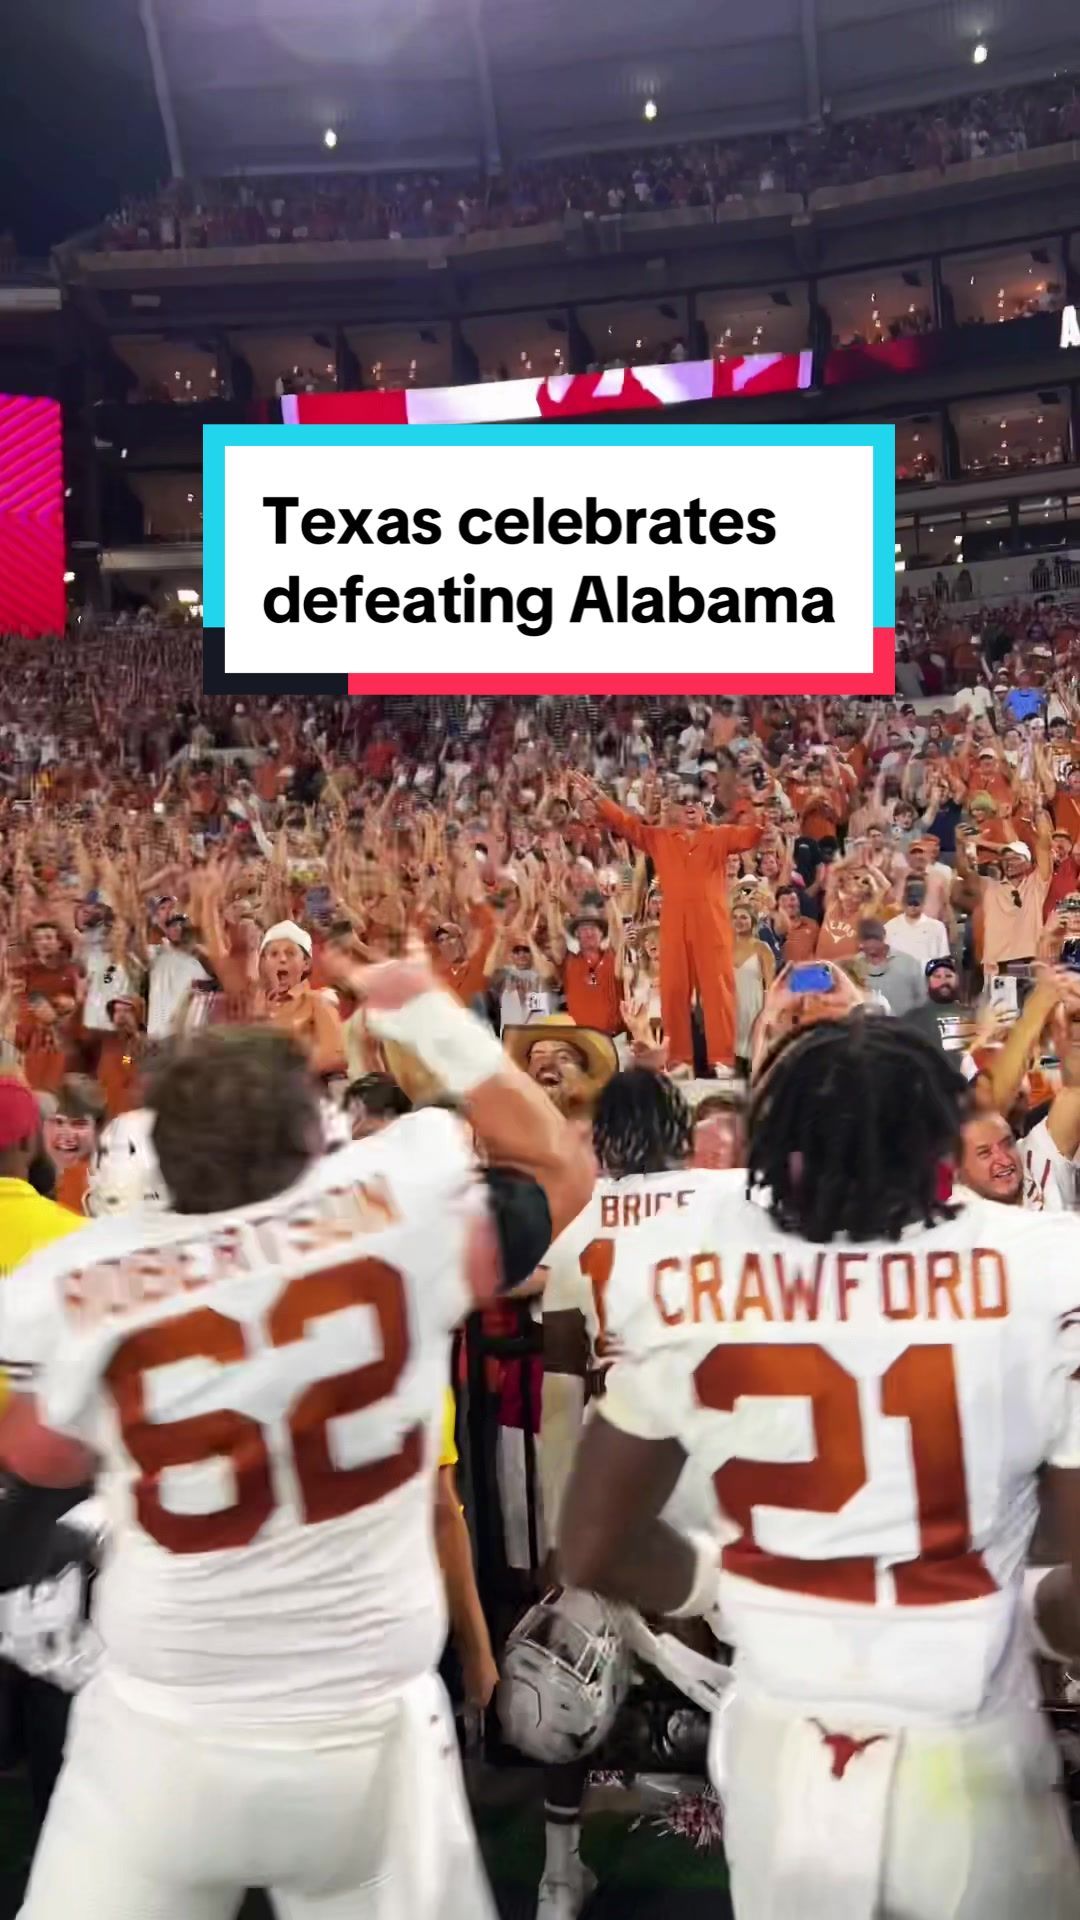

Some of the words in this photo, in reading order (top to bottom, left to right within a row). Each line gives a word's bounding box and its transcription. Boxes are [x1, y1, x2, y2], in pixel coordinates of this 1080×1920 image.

[104, 1255, 425, 1554] 62
[653, 1248, 1009, 1326] CRAWFORD
[693, 1343, 1001, 1606] 21
